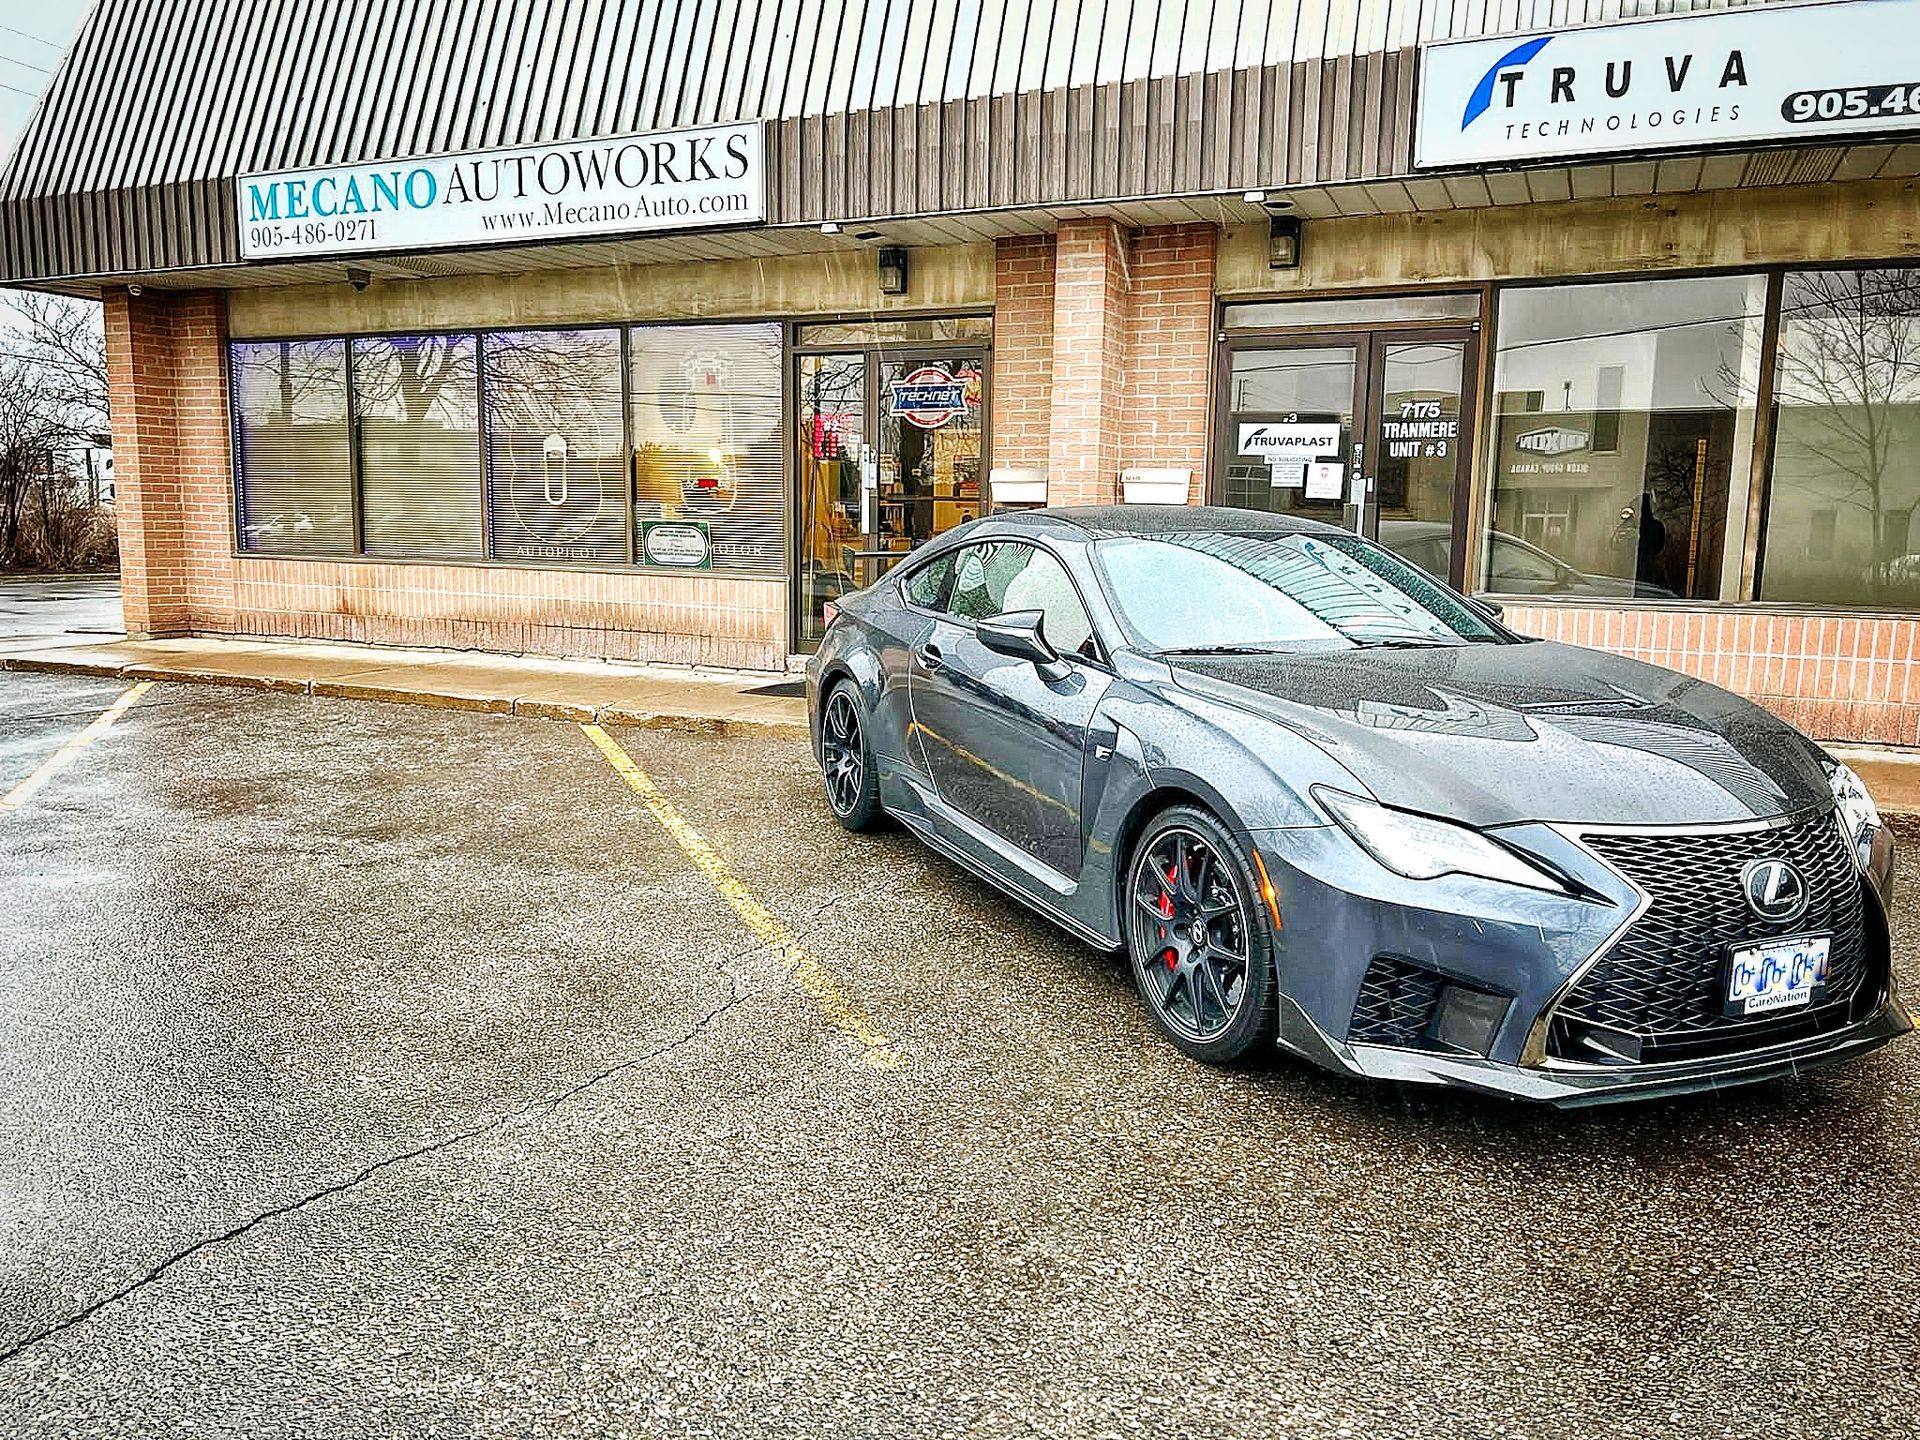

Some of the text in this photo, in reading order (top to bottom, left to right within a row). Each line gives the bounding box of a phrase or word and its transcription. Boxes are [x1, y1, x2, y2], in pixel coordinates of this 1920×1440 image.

[1500, 50, 1749, 108] TRUVA
[1505, 105, 1740, 140] TECHNOLOGIES
[248, 134, 749, 221] MECANO AUTOWORKS
[481, 189, 749, 232] www.MecanoAuto.com
[250, 219, 377, 248] 905-486-0271
[1400, 402, 1441, 419] 7175
[1254, 437, 1333, 446] TRUVAPLAST
[1382, 421, 1458, 438] TRANMERE
[1389, 441, 1422, 457] UNIT
